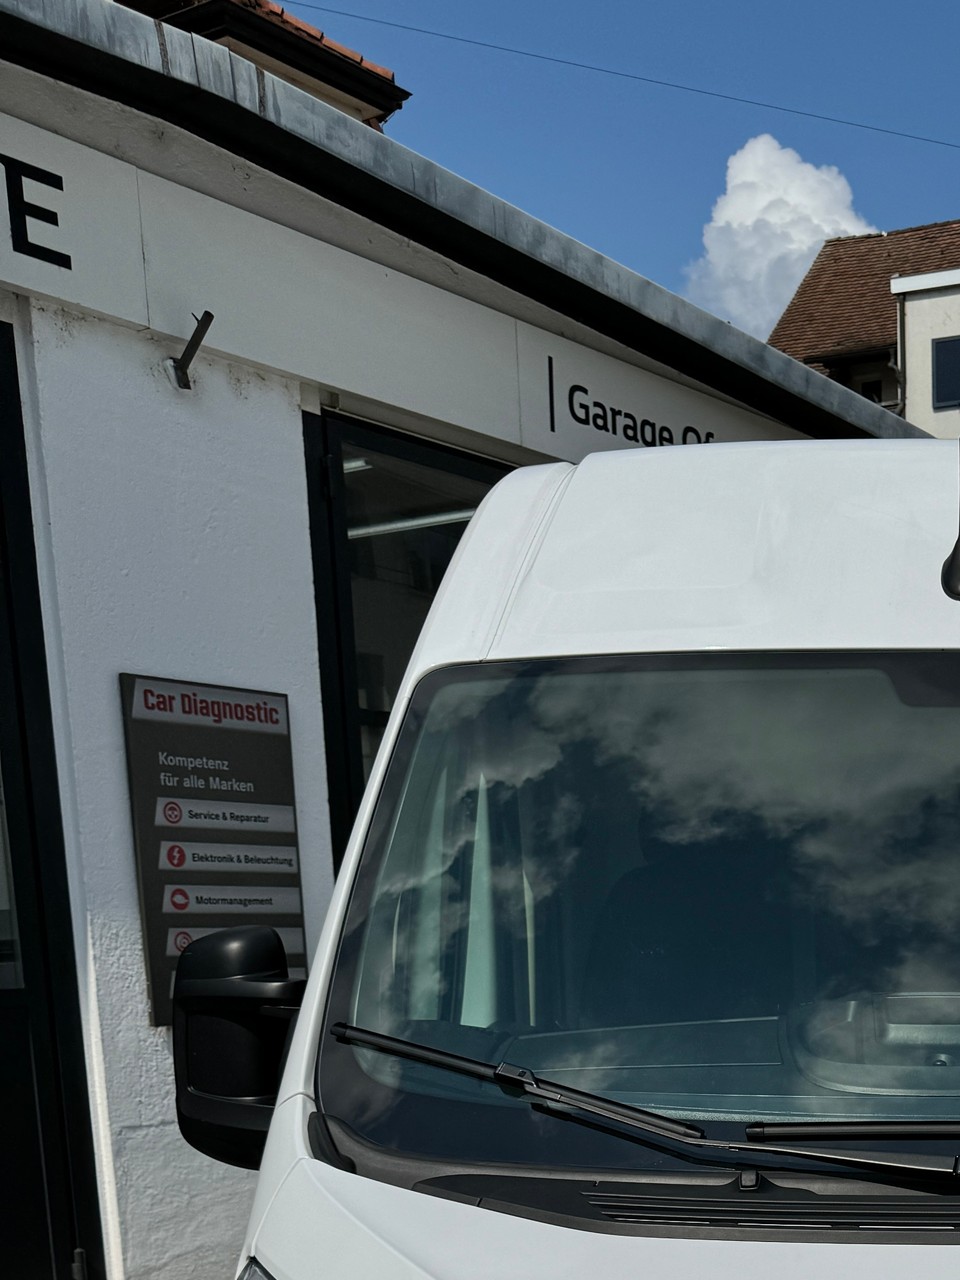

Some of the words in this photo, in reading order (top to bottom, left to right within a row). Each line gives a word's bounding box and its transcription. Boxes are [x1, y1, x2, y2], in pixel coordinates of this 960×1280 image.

[568, 384, 675, 447] Garage
[143, 688, 176, 713] Car
[180, 692, 280, 725] Diagnostic
[158, 751, 230, 771] Kompetenz
[159, 772, 179, 787] für
[183, 774, 206, 789] alle
[209, 776, 255, 792] Marken
[187, 809, 221, 822] Service
[222, 812, 228, 821] &
[229, 812, 270, 824] Reparatur
[192, 853, 235, 864] Elektronik
[236, 855, 243, 864] &
[244, 855, 294, 868] Beleuchtung
[195, 895, 274, 907] Motormanagement
